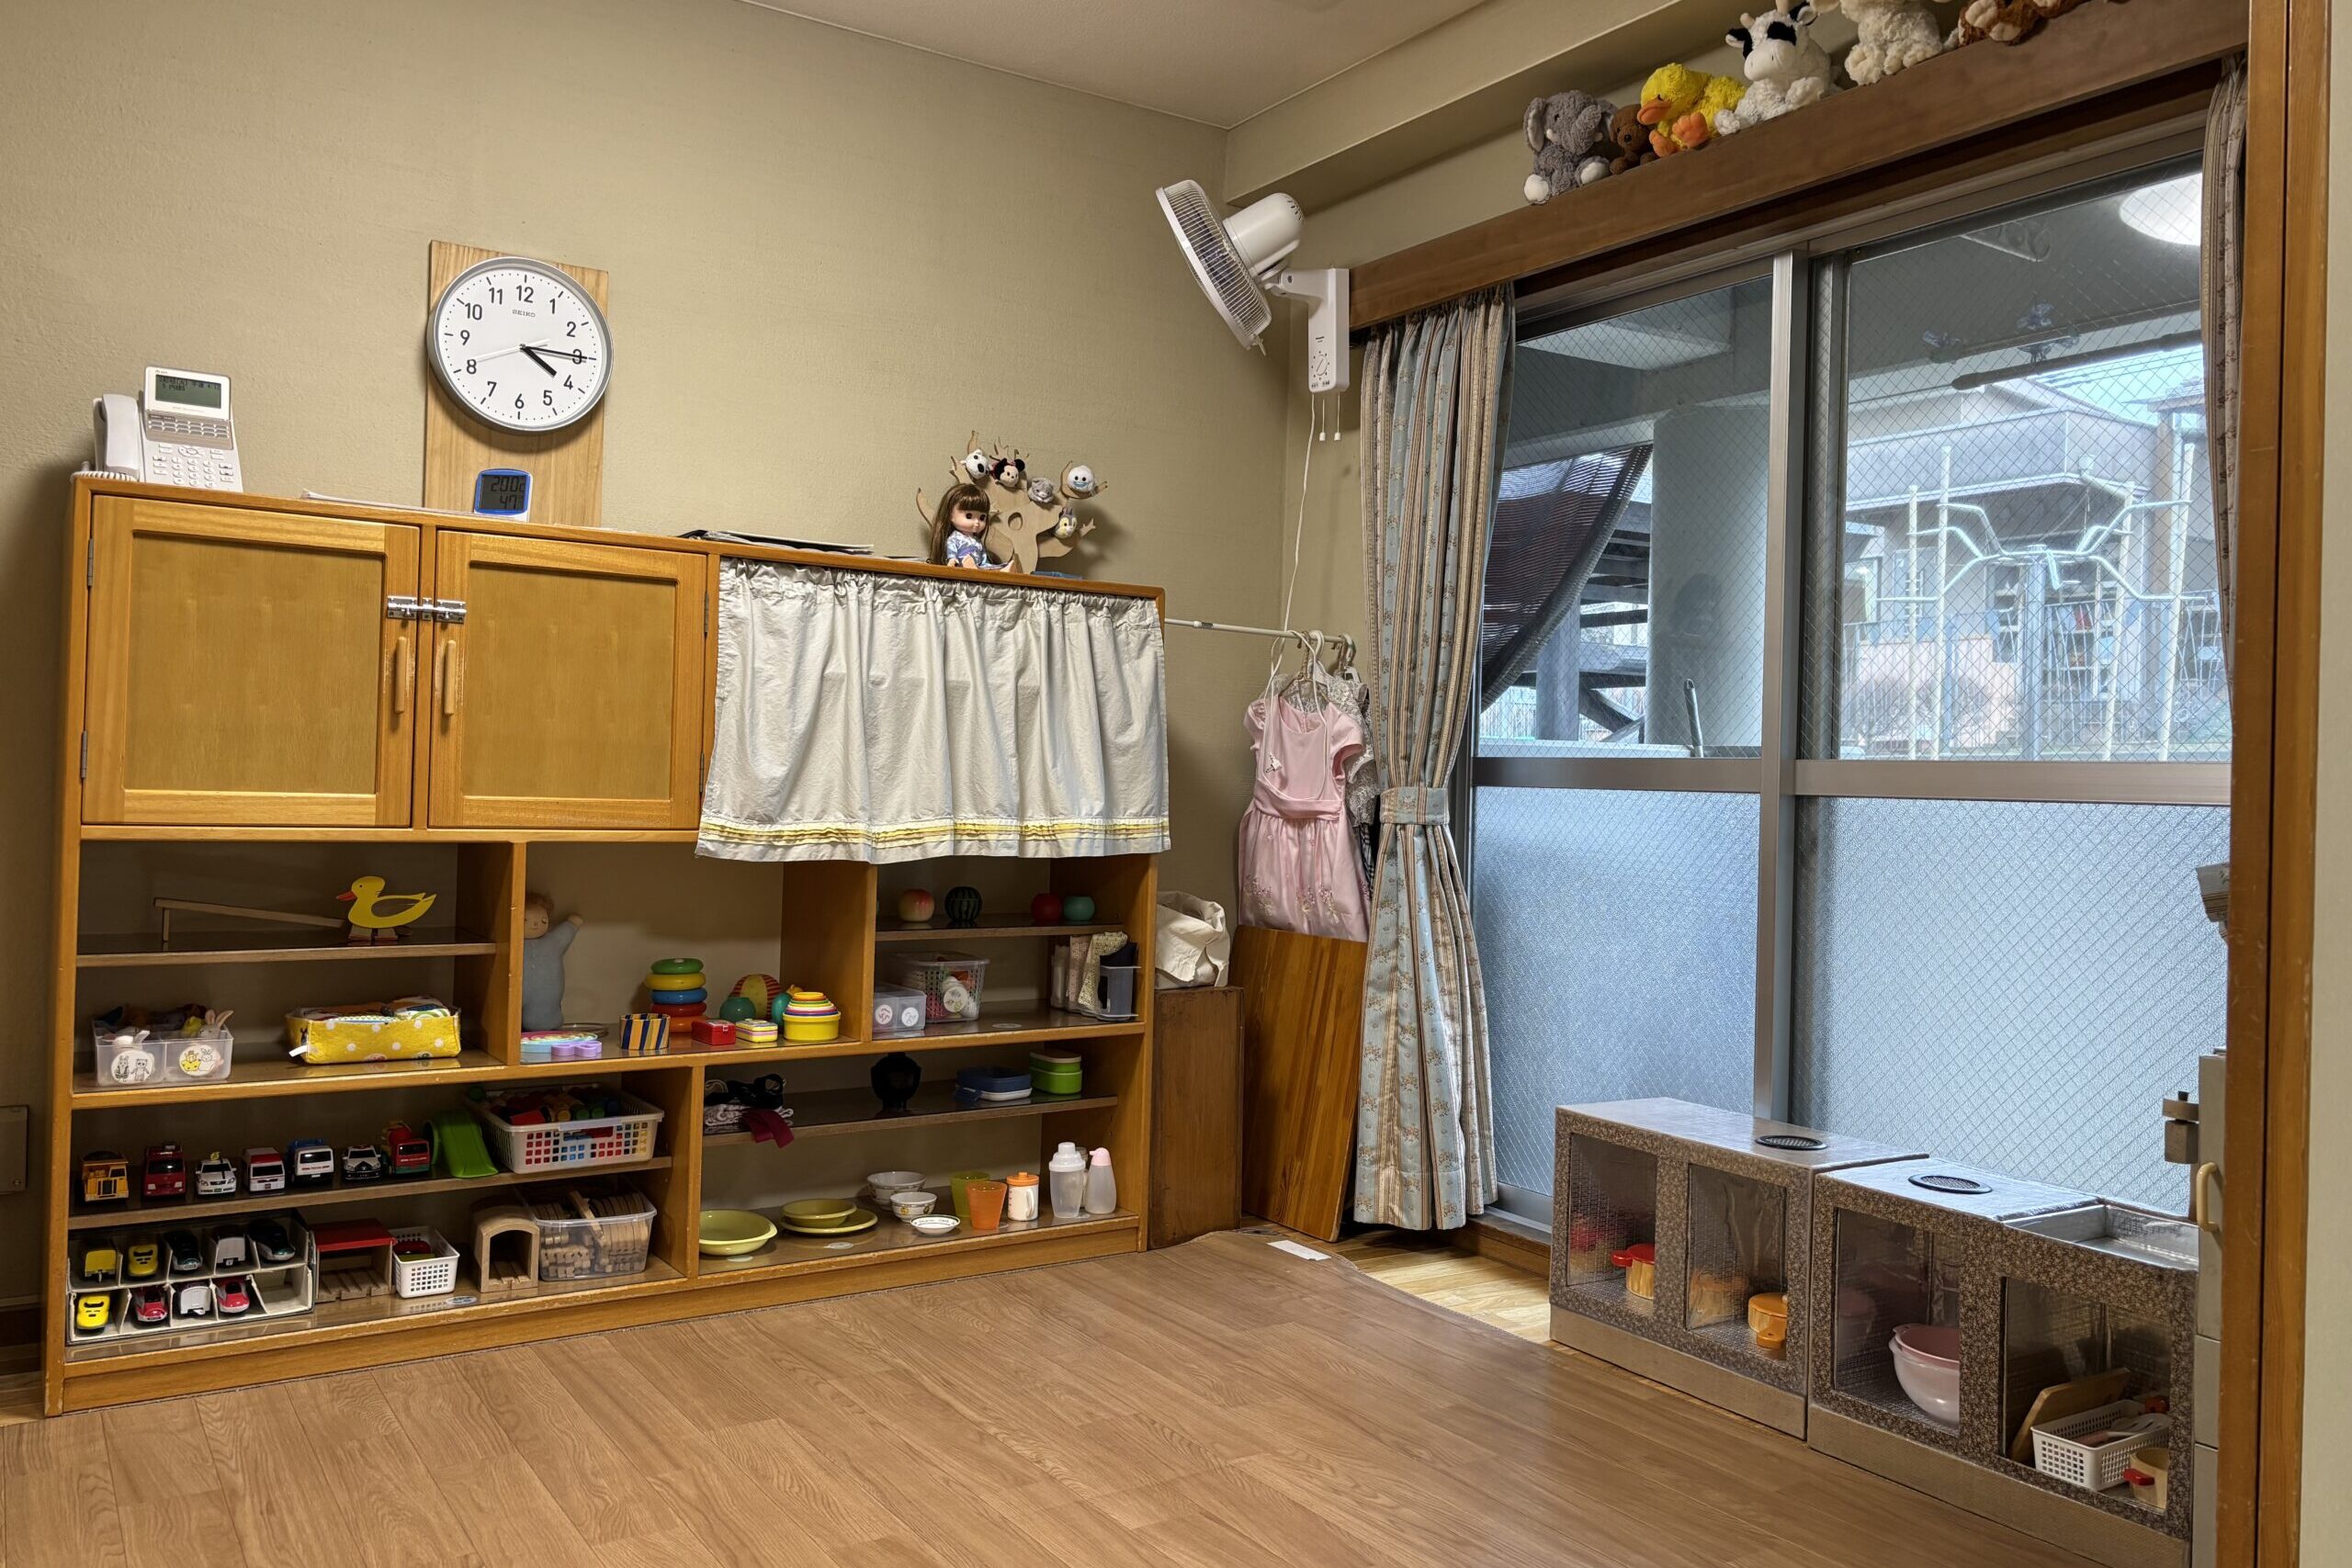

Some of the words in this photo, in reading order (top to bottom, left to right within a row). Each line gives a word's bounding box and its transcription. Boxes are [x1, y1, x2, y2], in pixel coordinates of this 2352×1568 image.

[489, 288, 503, 304] 11
[515, 286, 535, 302] 12
[465, 303, 483, 320] 10
[512, 309, 536, 318] SEIKO
[549, 299, 557, 314] 1
[566, 321, 577, 337] 2
[459, 330, 471, 345] 9
[572, 350, 582, 365] 3
[466, 359, 477, 375] 8
[487, 381, 498, 397] 7
[563, 375, 574, 390] 4
[514, 393, 525, 410] 6
[543, 390, 553, 406] 5
[500, 494, 517, 510] 47
